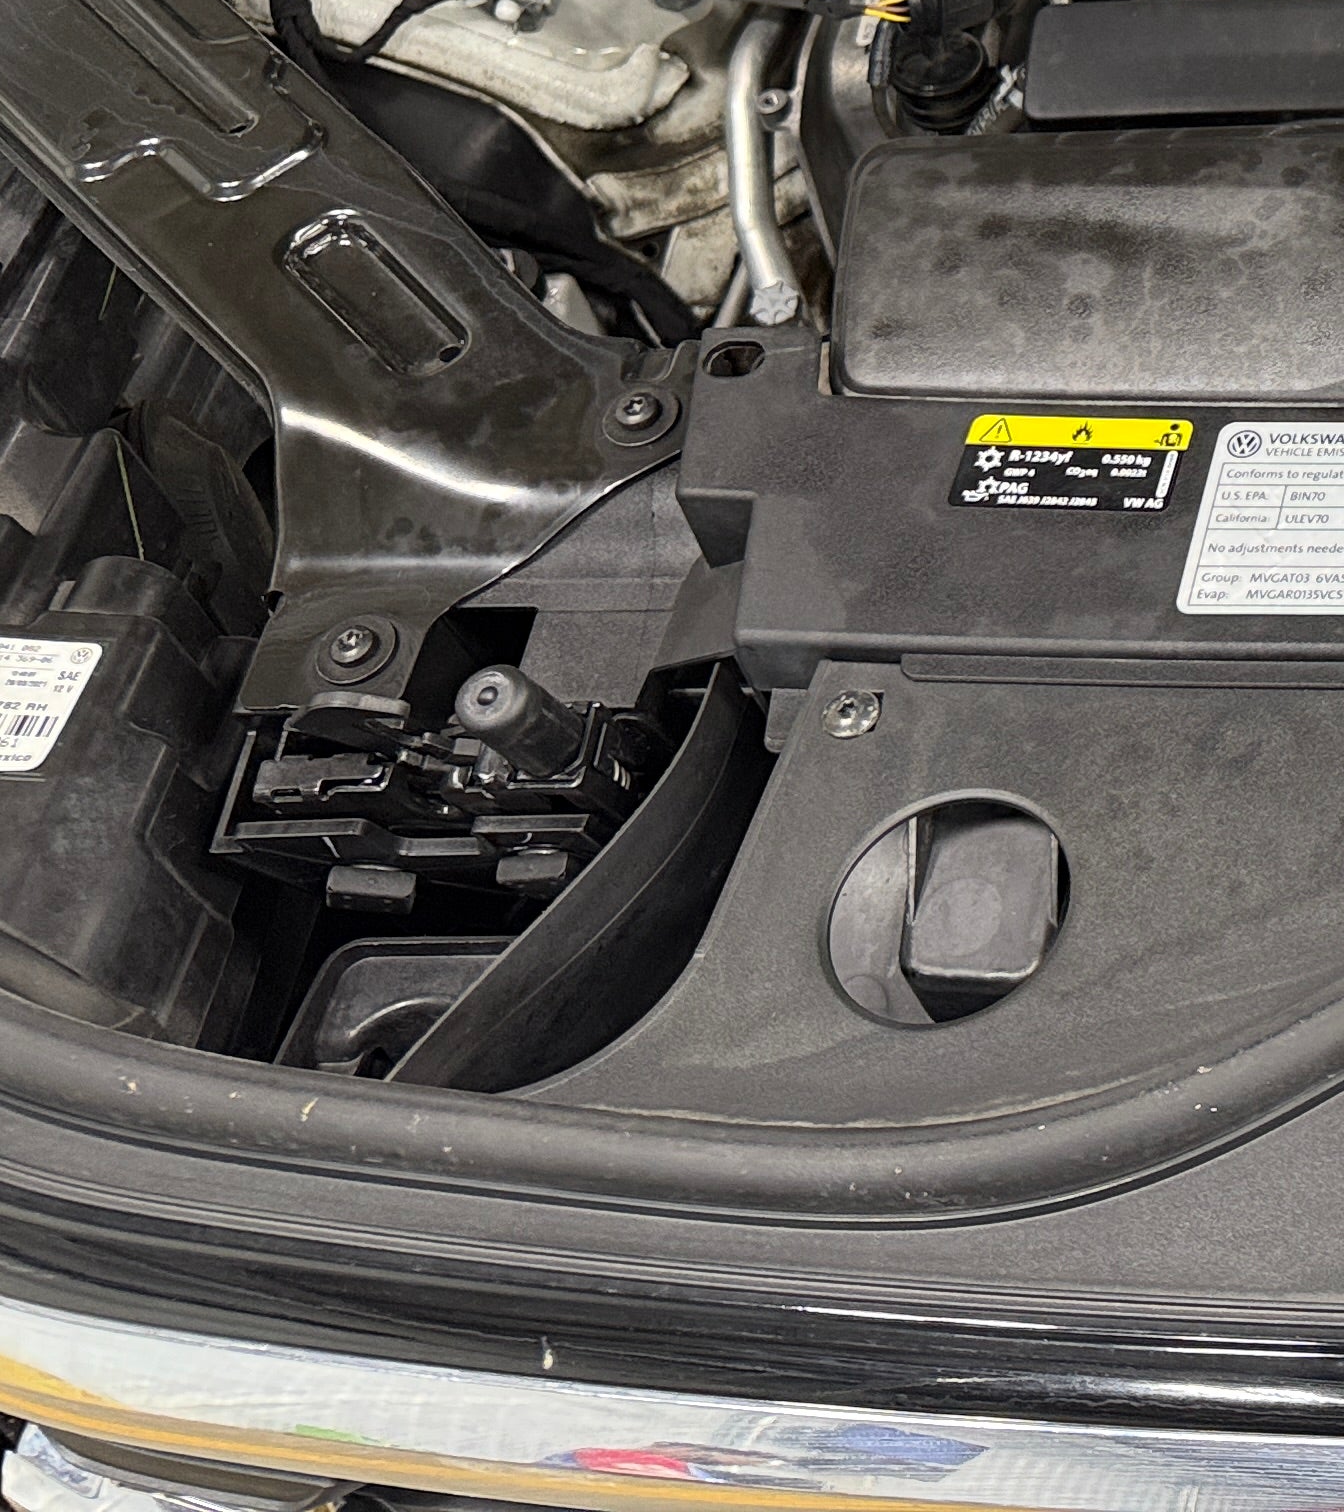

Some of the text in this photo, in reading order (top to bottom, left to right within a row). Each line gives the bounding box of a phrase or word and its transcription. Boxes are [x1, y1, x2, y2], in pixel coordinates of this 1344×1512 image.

[1265, 447, 1313, 456] VEHICLE
[1135, 454, 1151, 467] kg
[1226, 468, 1283, 478] Conforms
[1286, 469, 1299, 478] to
[997, 481, 1029, 494] PAG
[1289, 491, 1325, 501] BIN70
[1123, 497, 1163, 509] VW AG
[1284, 513, 1329, 523] ULEV70
[1207, 542, 1225, 552] No
[1227, 542, 1303, 556] adjustments
[1249, 572, 1310, 583] MVGAT03
[57, 670, 82, 681] SAE
